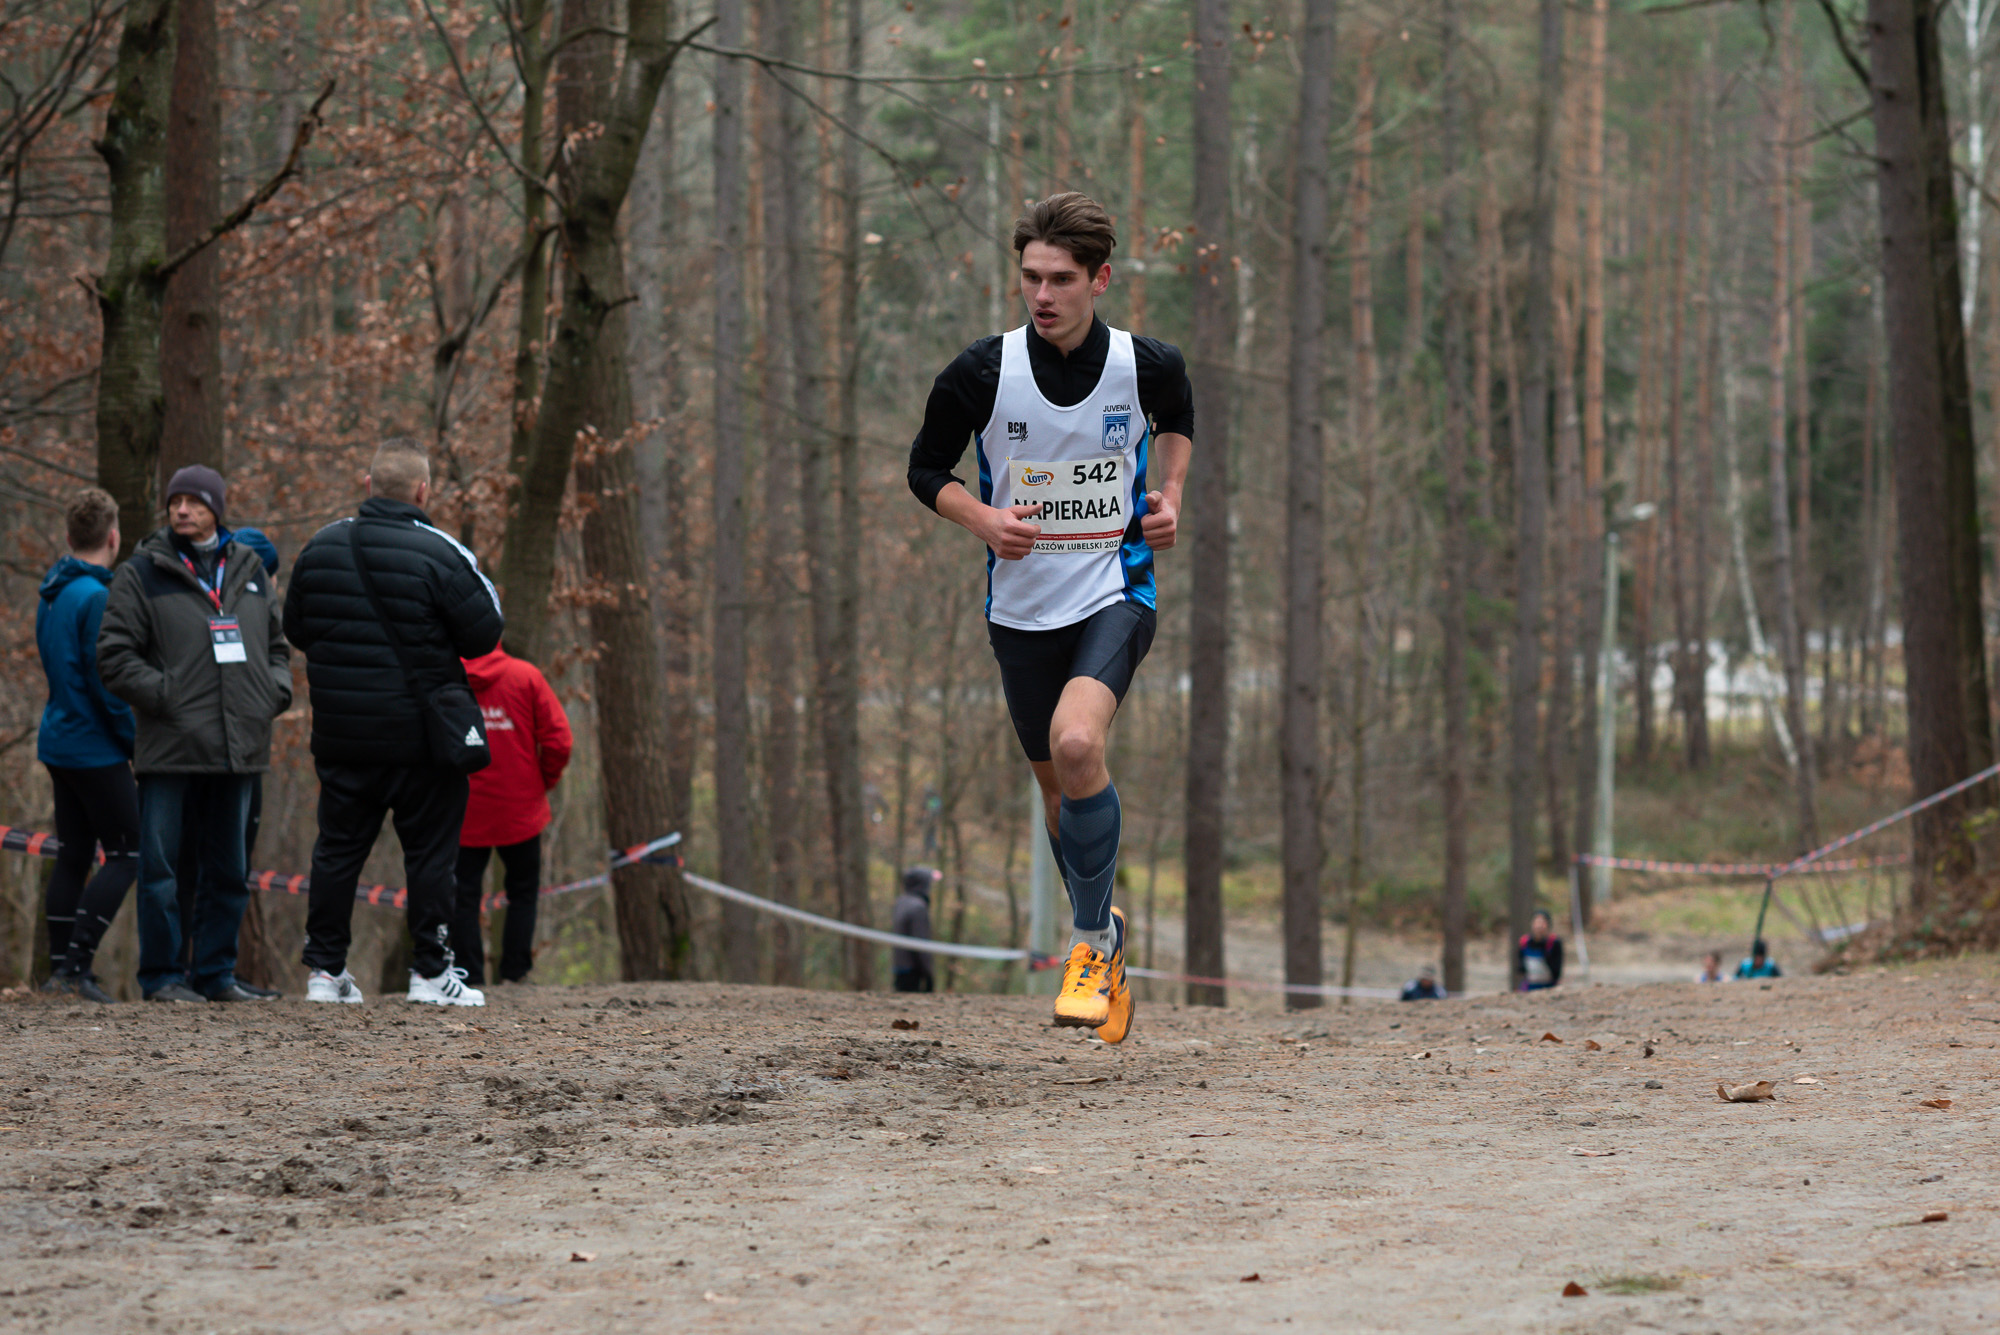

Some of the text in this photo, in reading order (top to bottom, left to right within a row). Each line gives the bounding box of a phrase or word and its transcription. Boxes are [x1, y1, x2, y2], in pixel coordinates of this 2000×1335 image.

[1103, 404, 1131, 412] JUVENIA
[1008, 421, 1027, 434] BCM
[1072, 461, 1117, 485] 542
[1027, 474, 1048, 483] LOTTO
[1067, 542, 1102, 550] LUBELSKI
